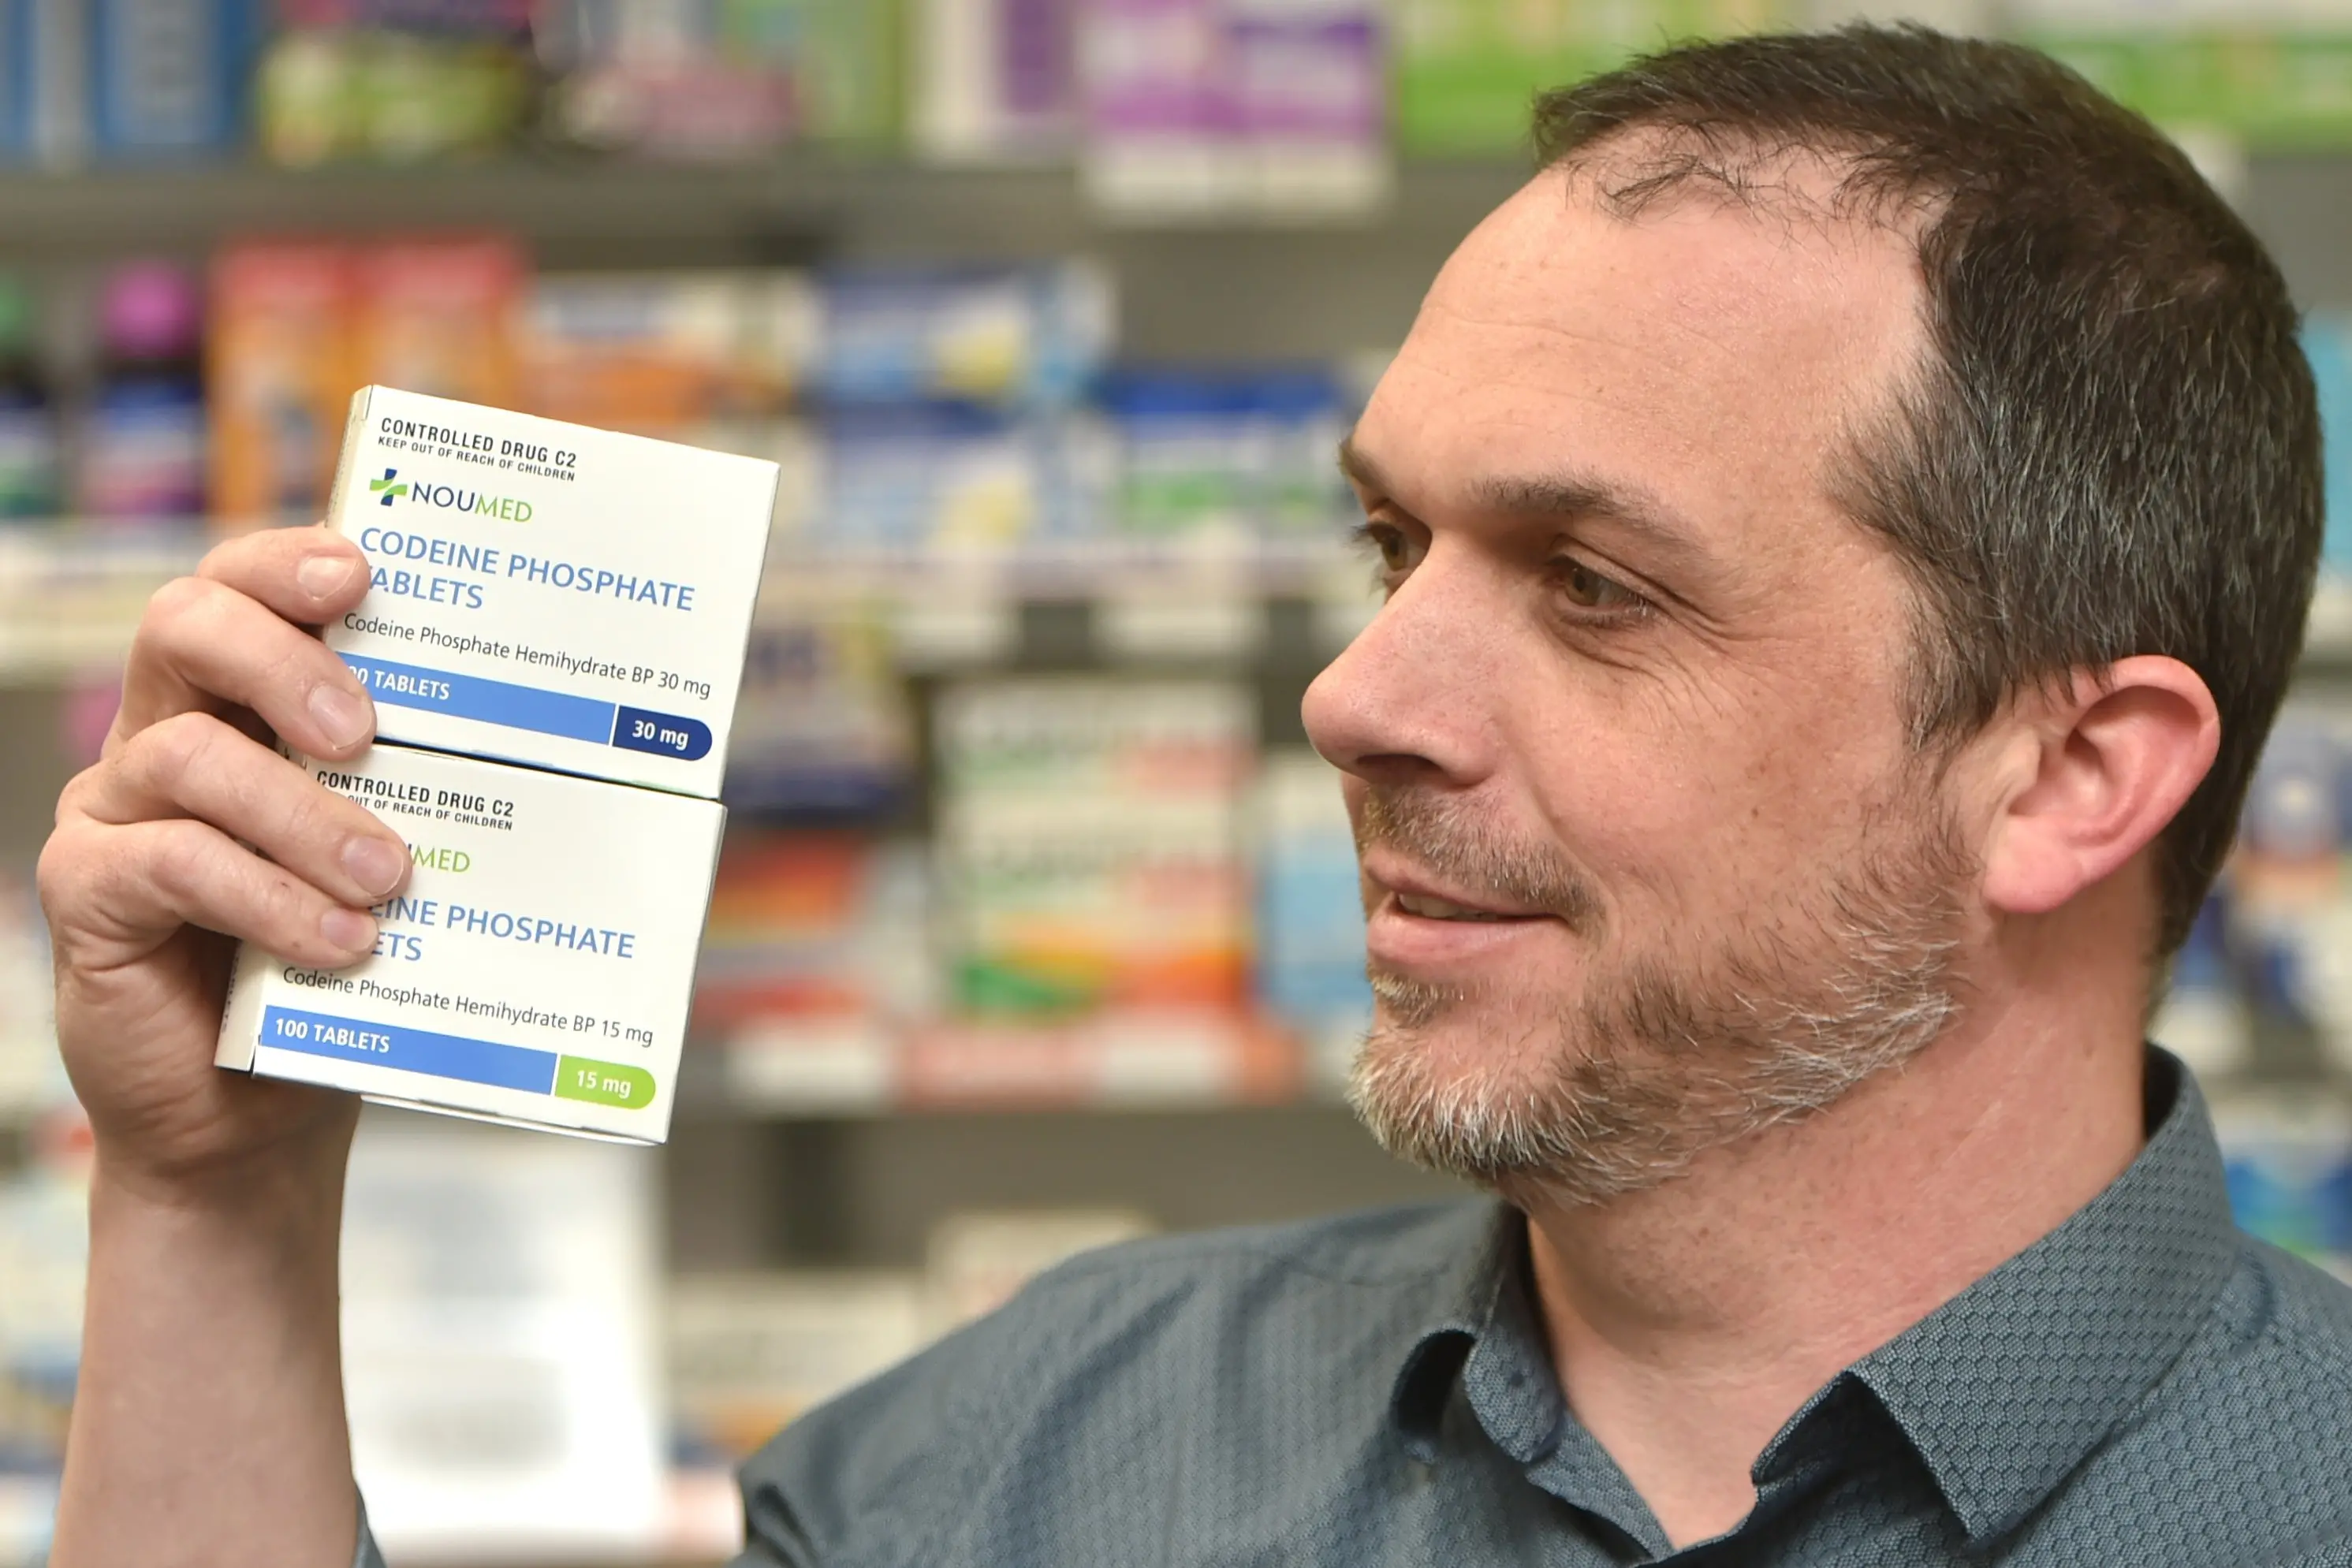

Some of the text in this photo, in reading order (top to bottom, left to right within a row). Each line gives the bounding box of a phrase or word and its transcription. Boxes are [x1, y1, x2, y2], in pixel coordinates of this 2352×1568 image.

[378, 435, 576, 482] KEEP OUT OF REACH OF CHILDREN
[381, 417, 576, 468] CONTROLLED DRUG C2
[411, 481, 533, 523] NOUMED
[360, 527, 695, 612] CODEINE PHOSPHATE
[369, 565, 483, 609] ABLETS
[344, 613, 711, 700] Codeine Phosphate Hemihydrate BP 30 mg
[375, 670, 450, 701] TABLETS
[632, 720, 689, 751] 30 mg
[317, 770, 514, 818] CONTROLLED DRUG C2
[374, 799, 389, 810] OF
[393, 802, 431, 818] REACH
[435, 809, 451, 821] OF
[454, 812, 513, 831] CHILDREN
[408, 844, 471, 873] MED
[446, 905, 636, 959] PHOSPHATE
[284, 966, 654, 1048] Codeine Phosphate Hemihydrate BP 15 mg
[276, 1018, 390, 1053] 100 TABLETS
[577, 1070, 632, 1100] 15 mg
